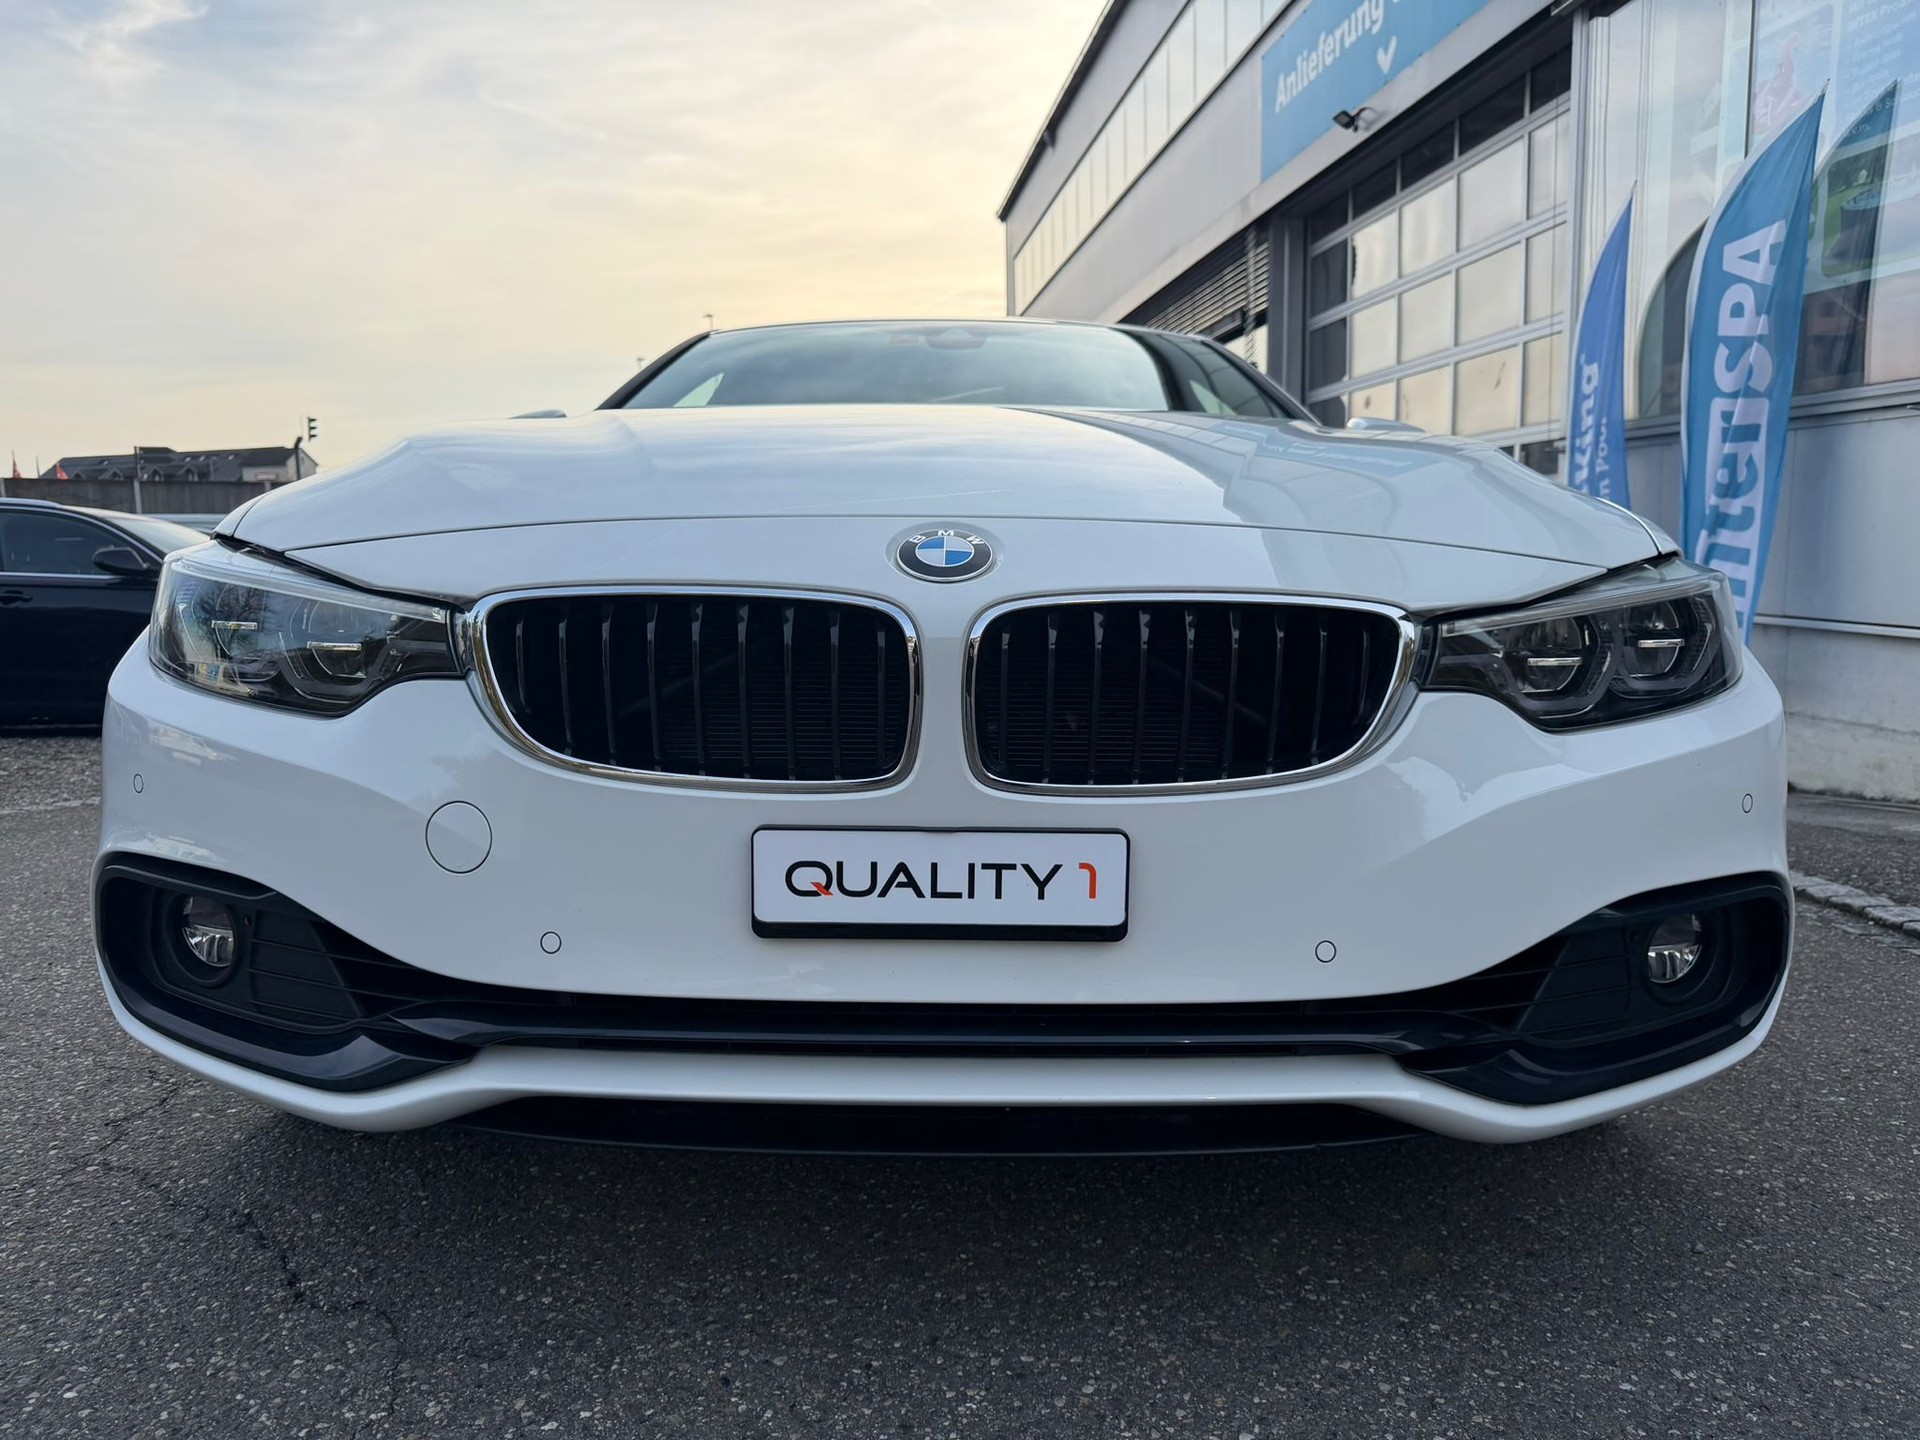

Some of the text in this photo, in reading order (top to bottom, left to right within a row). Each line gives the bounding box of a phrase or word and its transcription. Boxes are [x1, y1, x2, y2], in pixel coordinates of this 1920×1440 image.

[1275, 0, 1384, 114] Anlieferung
[1702, 219, 1787, 628] nterSPA
[908, 529, 985, 545] BMW
[785, 860, 1097, 900] QUALITY 1
